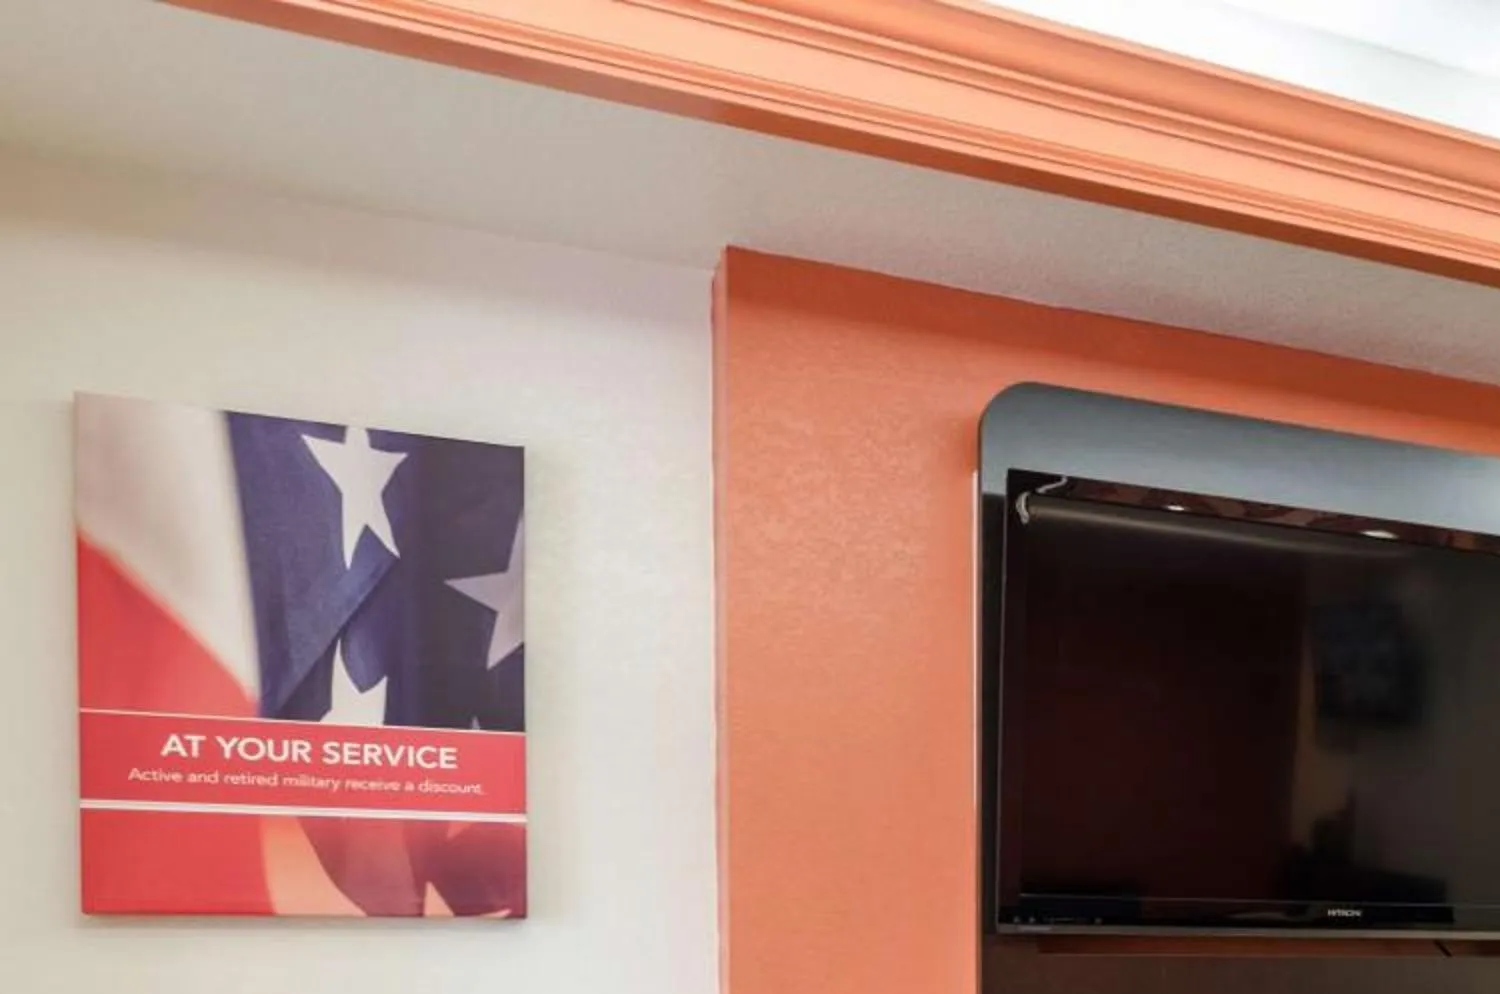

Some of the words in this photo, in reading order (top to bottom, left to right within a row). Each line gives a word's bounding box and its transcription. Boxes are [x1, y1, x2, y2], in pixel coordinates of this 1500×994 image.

[160, 733, 206, 759] AT
[216, 736, 312, 764] YOUR
[322, 741, 458, 769] SERVICE
[128, 767, 183, 783] Active
[187, 770, 219, 785] and
[224, 771, 279, 787] retired
[283, 774, 341, 794] military
[345, 777, 401, 792] receive
[404, 782, 415, 792] a
